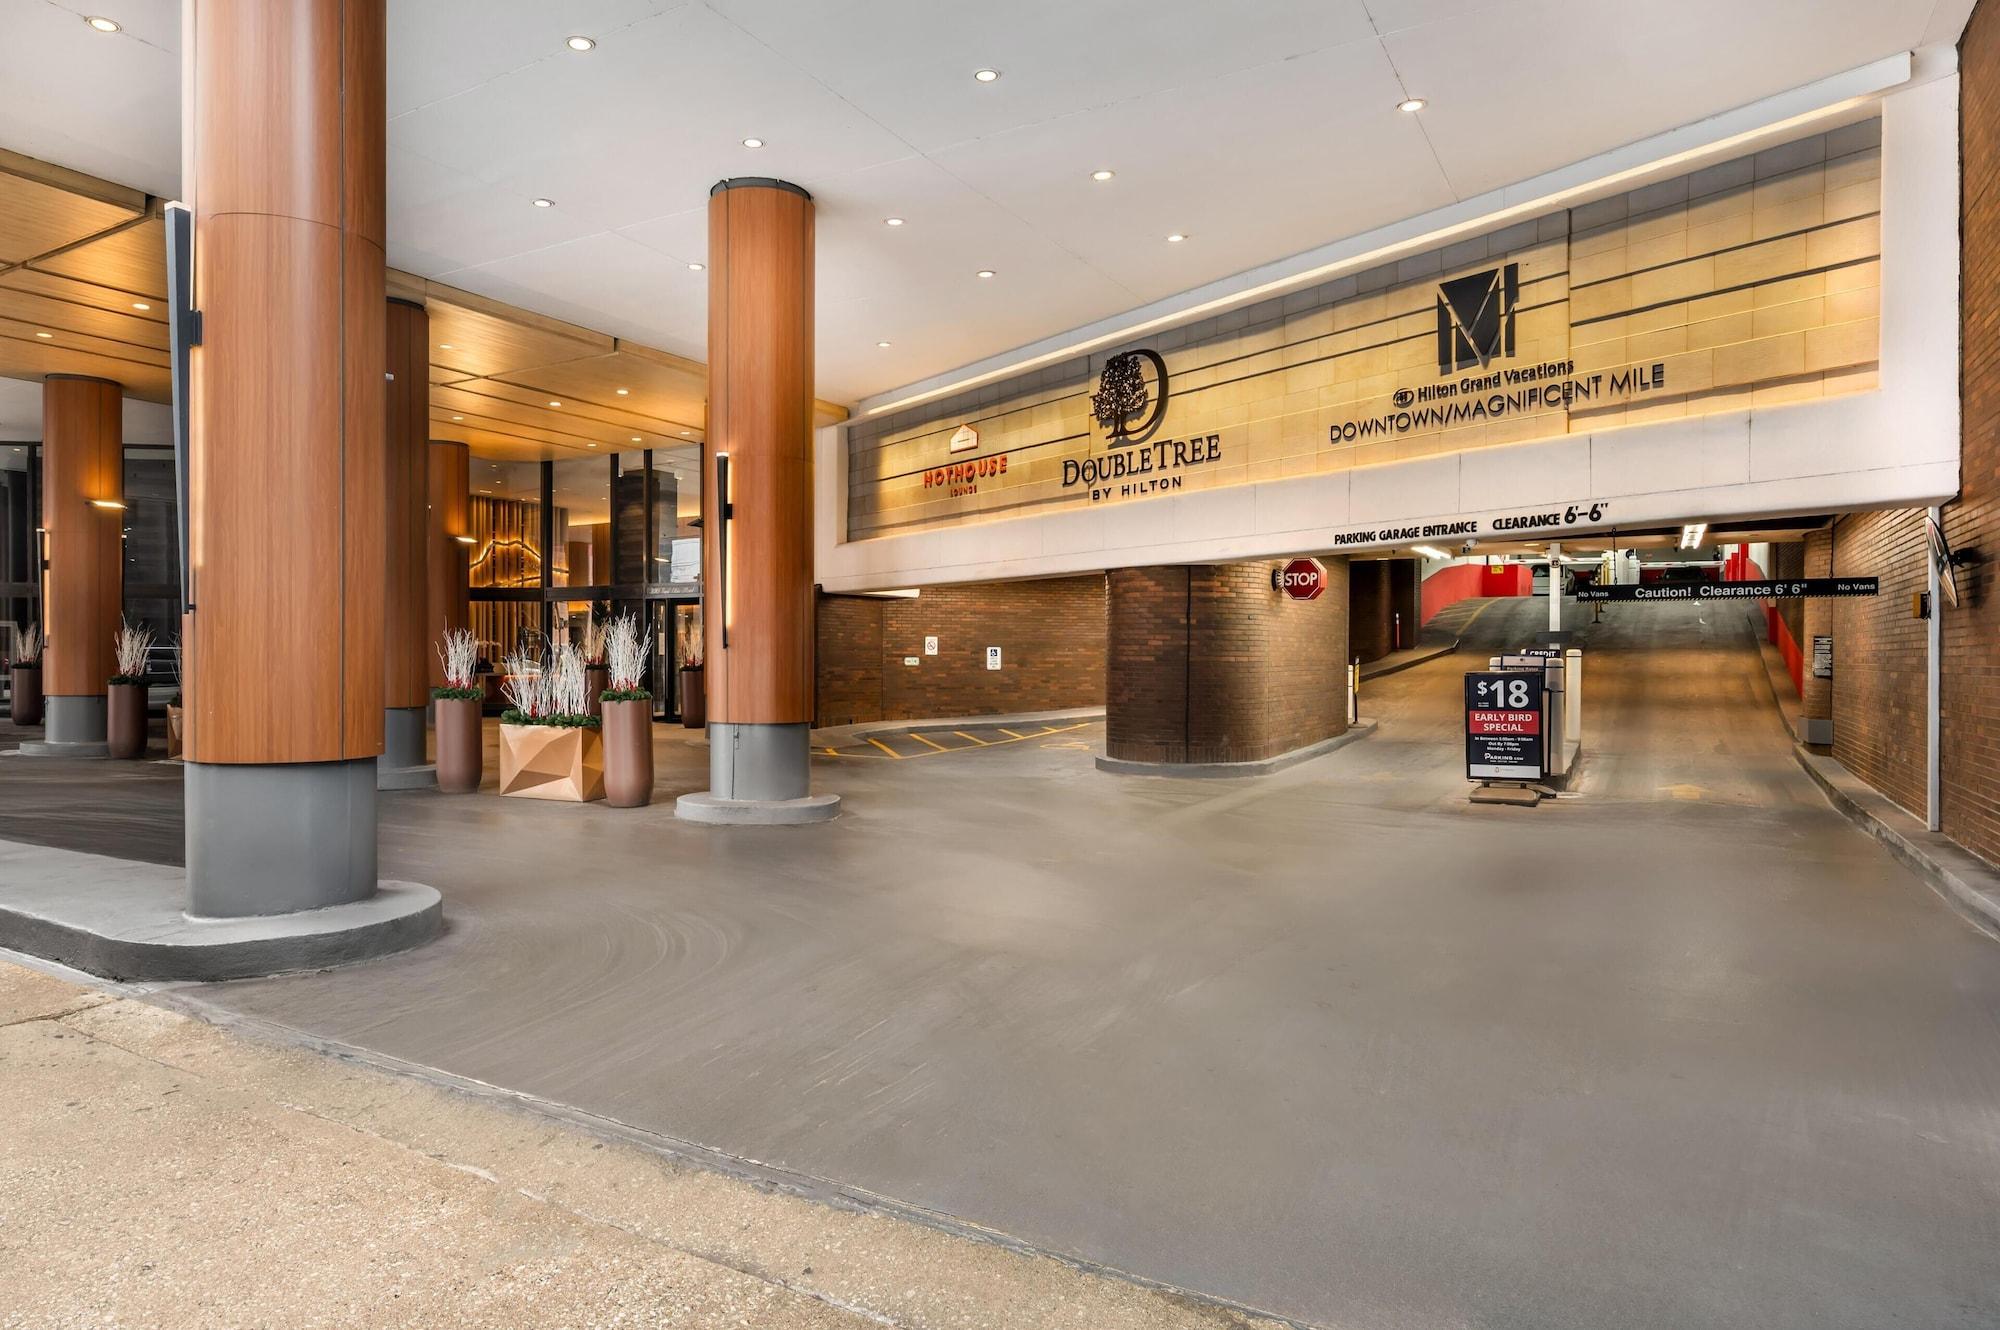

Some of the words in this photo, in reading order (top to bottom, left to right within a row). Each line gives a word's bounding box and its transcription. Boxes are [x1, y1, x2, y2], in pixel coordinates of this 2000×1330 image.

[1418, 383, 1457, 402] Hilton
[1460, 371, 1501, 394] Grand
[1504, 360, 1575, 383] Vacations
[1330, 375, 1602, 443] DOWNTOWN/MAGNIFICENT
[1610, 363, 1665, 396] MILE
[924, 455, 1008, 488] HOTHOUSE
[950, 485, 978, 498] LOUNGE
[1092, 488, 1111, 501] BY
[1121, 476, 1182, 497] HILTON
[1334, 530, 1376, 545] PARKING
[1379, 526, 1420, 541] GARAGE
[1423, 521, 1478, 537] ENTRANCE
[1492, 514, 1560, 530] CLEARANCE
[1284, 572, 1318, 586] STOP
[1590, 590, 1609, 598] Vans
[1635, 587, 1692, 598] Caution!
[1700, 584, 1771, 597] Clearance
[1774, 584, 1787, 595] 6'
[1853, 583, 1876, 591] Vans
[1529, 650, 1557, 658] CREDIT
[1477, 680, 1529, 708] $18
[1475, 713, 1505, 721] EARLY
[1508, 713, 1533, 721] BIRD
[1483, 723, 1524, 731] SPECIAL
